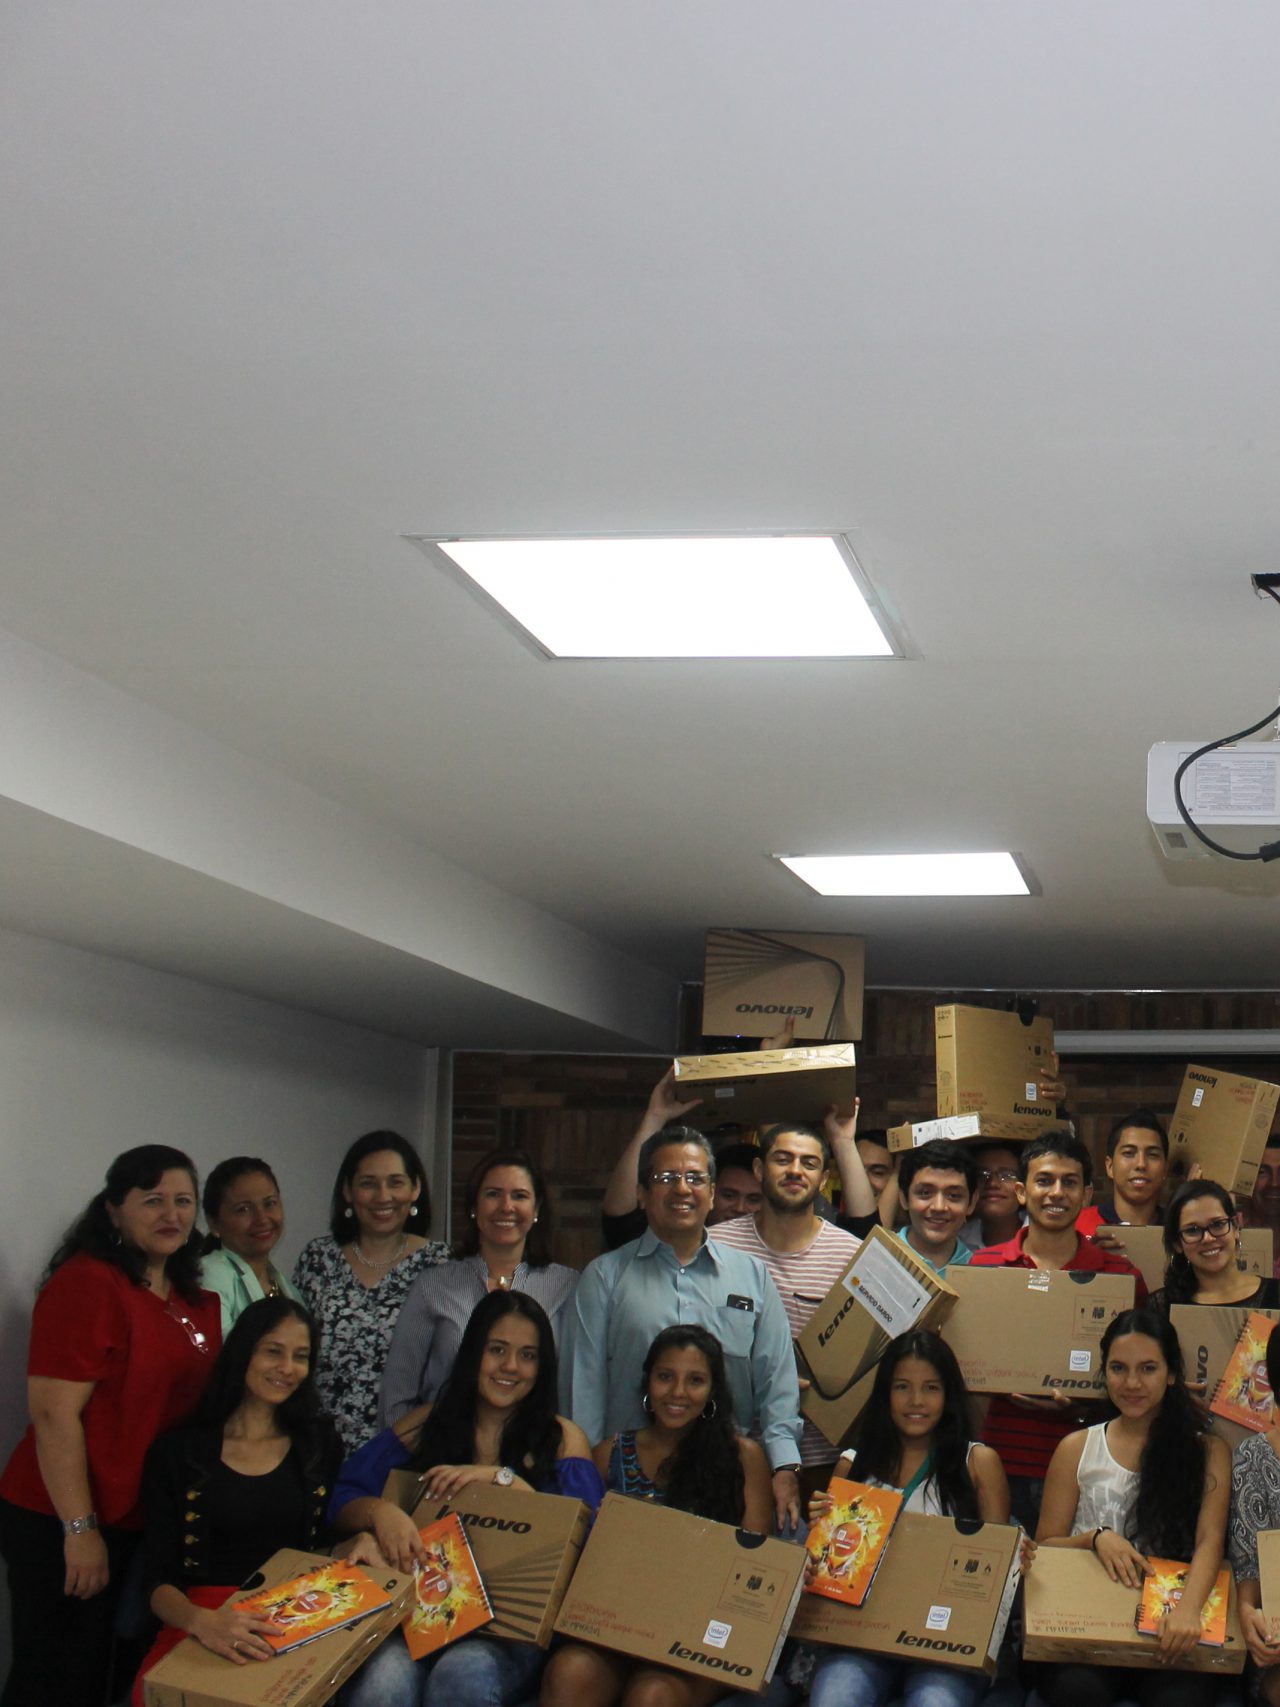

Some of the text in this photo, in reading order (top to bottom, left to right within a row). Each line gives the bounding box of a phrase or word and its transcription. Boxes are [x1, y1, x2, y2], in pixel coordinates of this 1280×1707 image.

[735, 1003, 814, 1019] lenovo
[1188, 1071, 1218, 1088] lenovo
[1013, 1103, 1052, 1117] lenovo
[818, 1295, 855, 1347] leno
[1042, 1375, 1104, 1389] lenov
[895, 1630, 976, 1655] lenovo
[668, 1641, 753, 1677] lenovo
